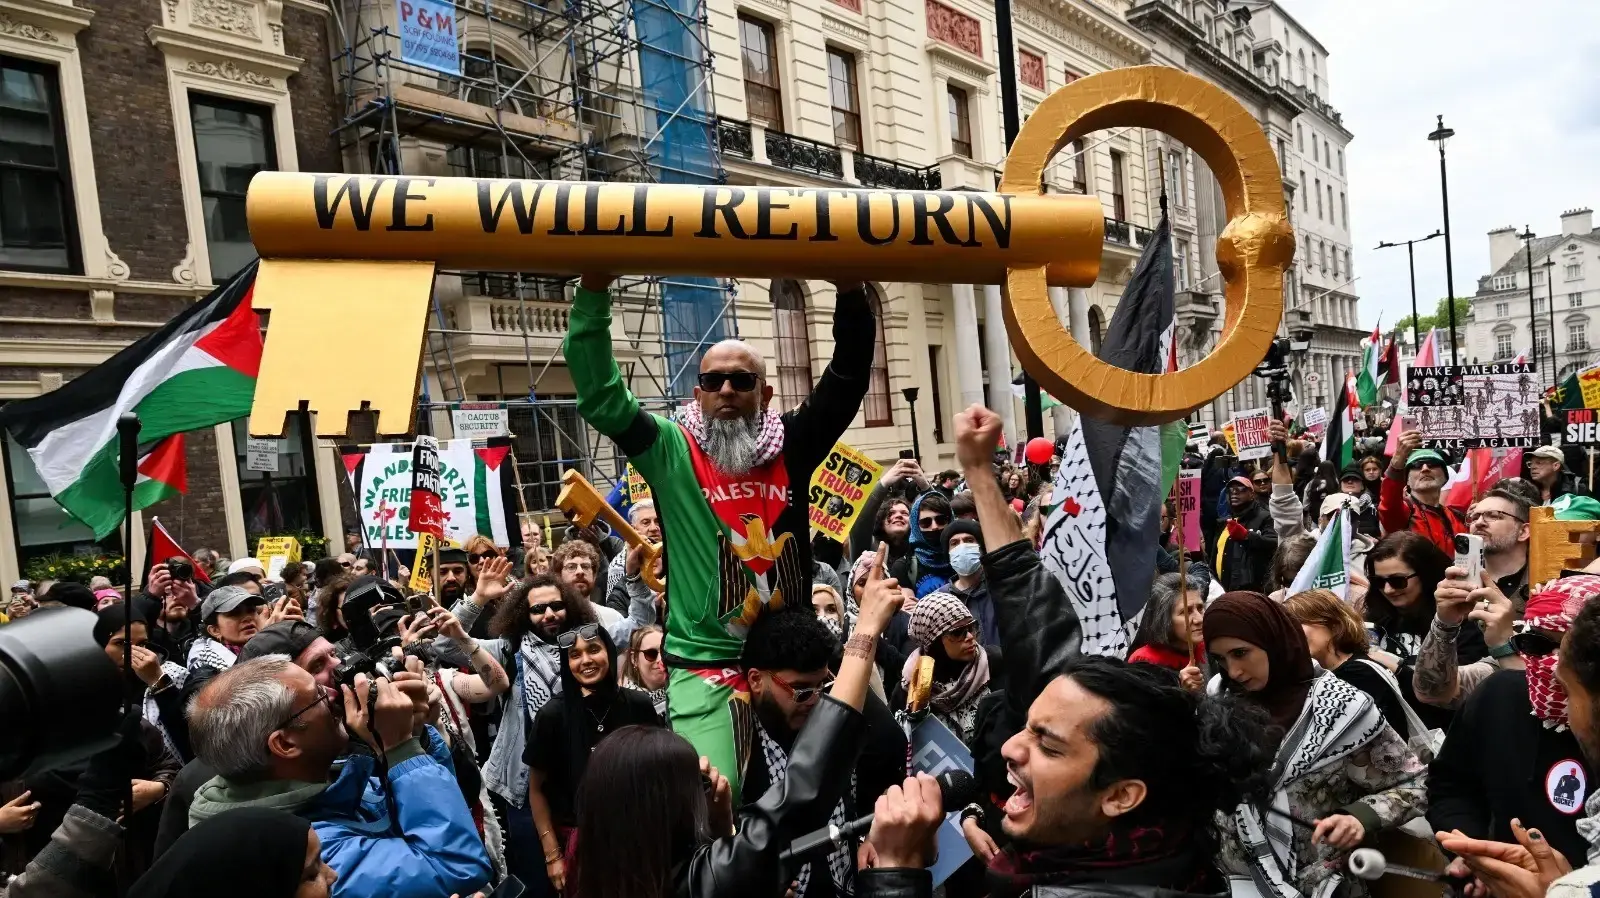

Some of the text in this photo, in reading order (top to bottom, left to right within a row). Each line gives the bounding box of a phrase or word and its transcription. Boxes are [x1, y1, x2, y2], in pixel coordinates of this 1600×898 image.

[312, 174, 1016, 249] WE WILL RETURN
[1413, 364, 1531, 377] MAKE AMERICA
[467, 413, 500, 421] CACTUS
[1567, 409, 1592, 424] END
[459, 422, 499, 430] SECURITY
[1235, 416, 1269, 434] FREEDOM
[1237, 431, 1270, 448] PALESTIN
[1421, 437, 1533, 449] FAKE AGAIN
[817, 468, 864, 502] TRUMP
[398, 506, 410, 520] O
[1553, 795, 1575, 808] HOCKEY
